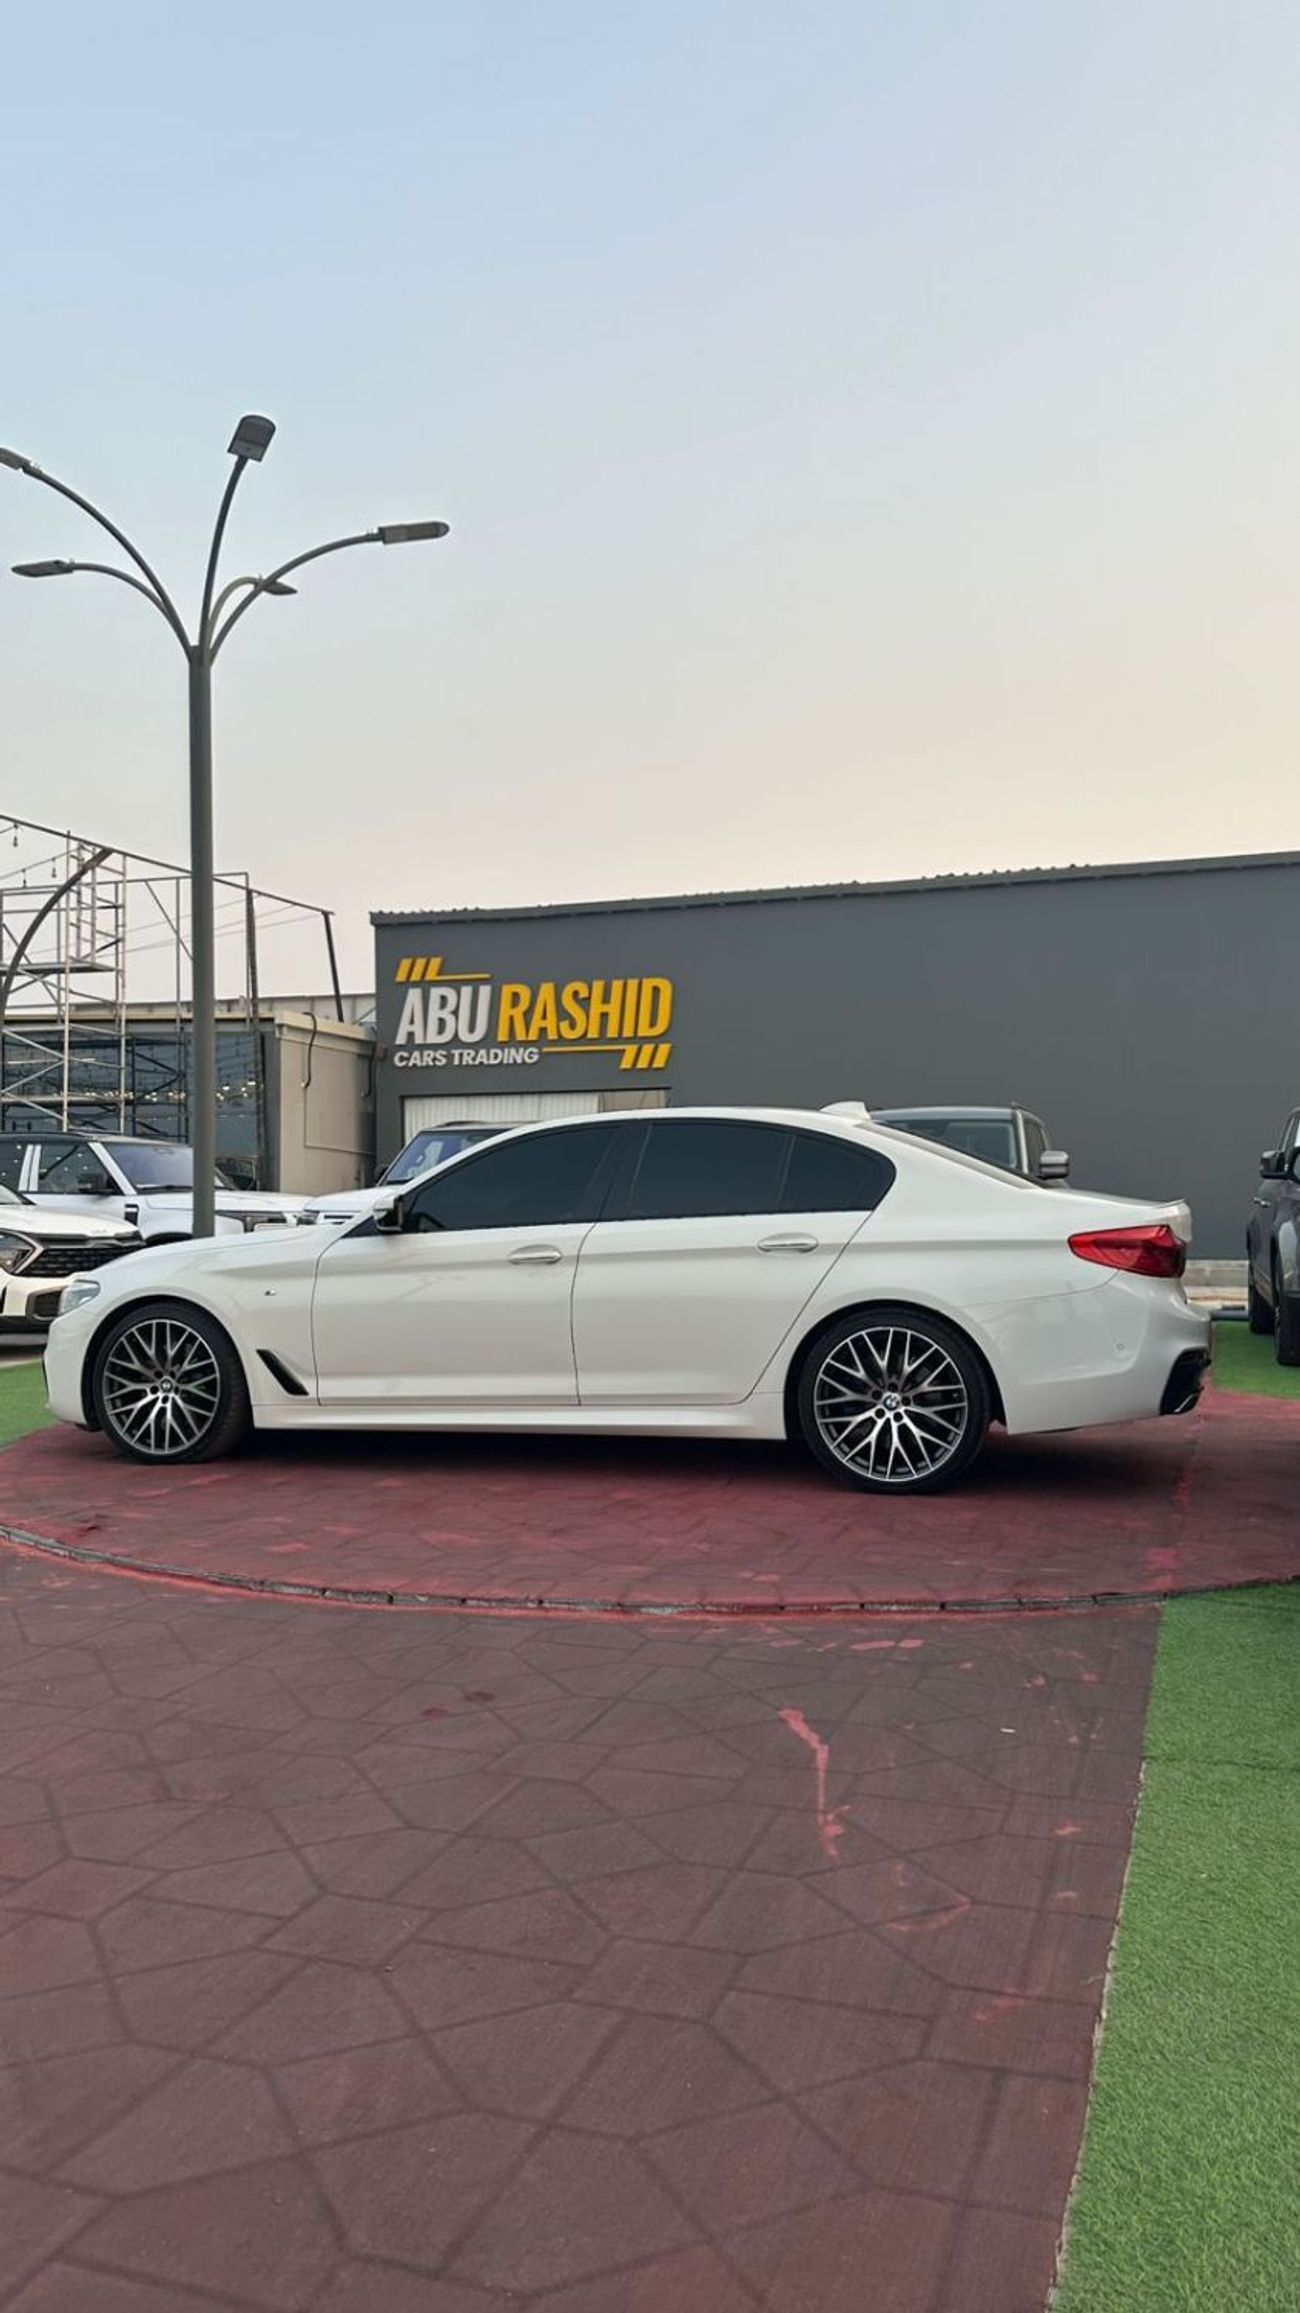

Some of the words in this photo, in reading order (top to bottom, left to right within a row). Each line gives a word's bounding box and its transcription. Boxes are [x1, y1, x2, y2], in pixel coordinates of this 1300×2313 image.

[395, 985, 491, 1045] ABU
[497, 977, 672, 1042] RASHID
[394, 1049, 447, 1067] CARS
[452, 1047, 539, 1065] TRADING
